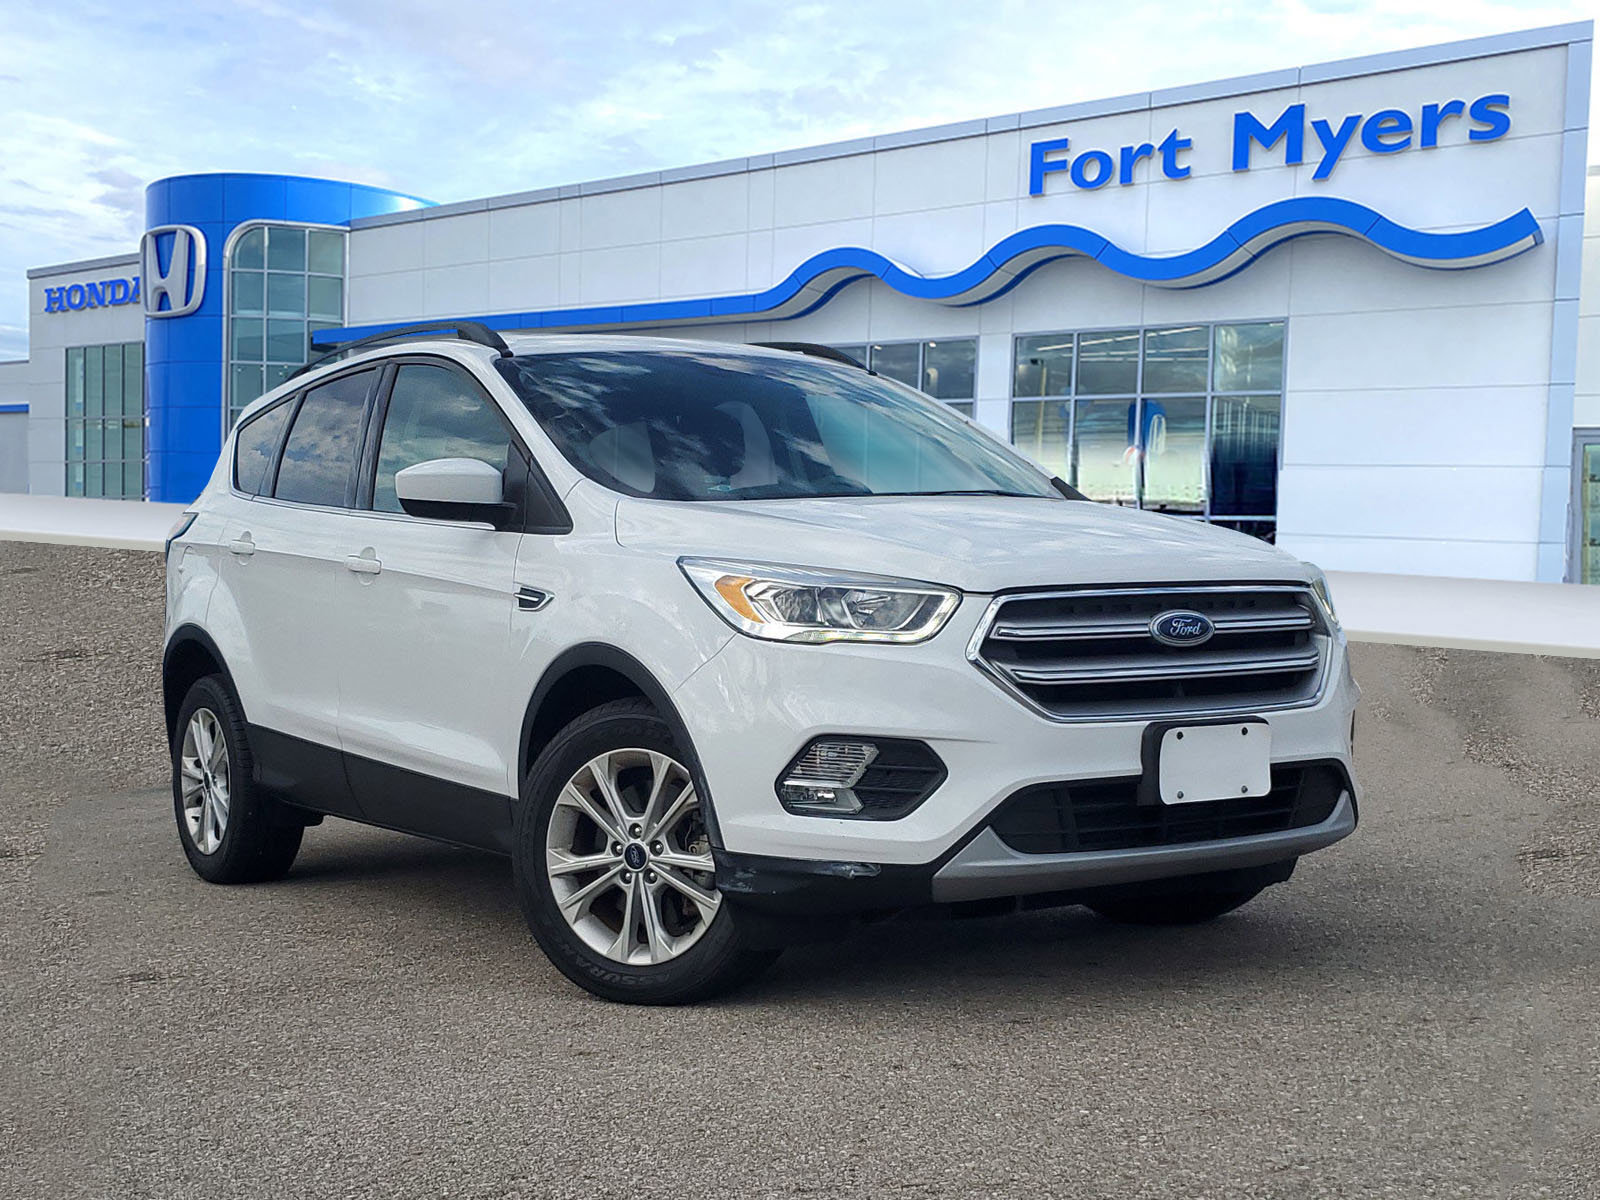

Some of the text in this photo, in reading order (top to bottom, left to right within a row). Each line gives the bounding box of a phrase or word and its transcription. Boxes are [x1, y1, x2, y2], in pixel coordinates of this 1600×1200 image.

[1029, 93, 1512, 197] Fort Myers
[1170, 619, 1201, 635] Ford
